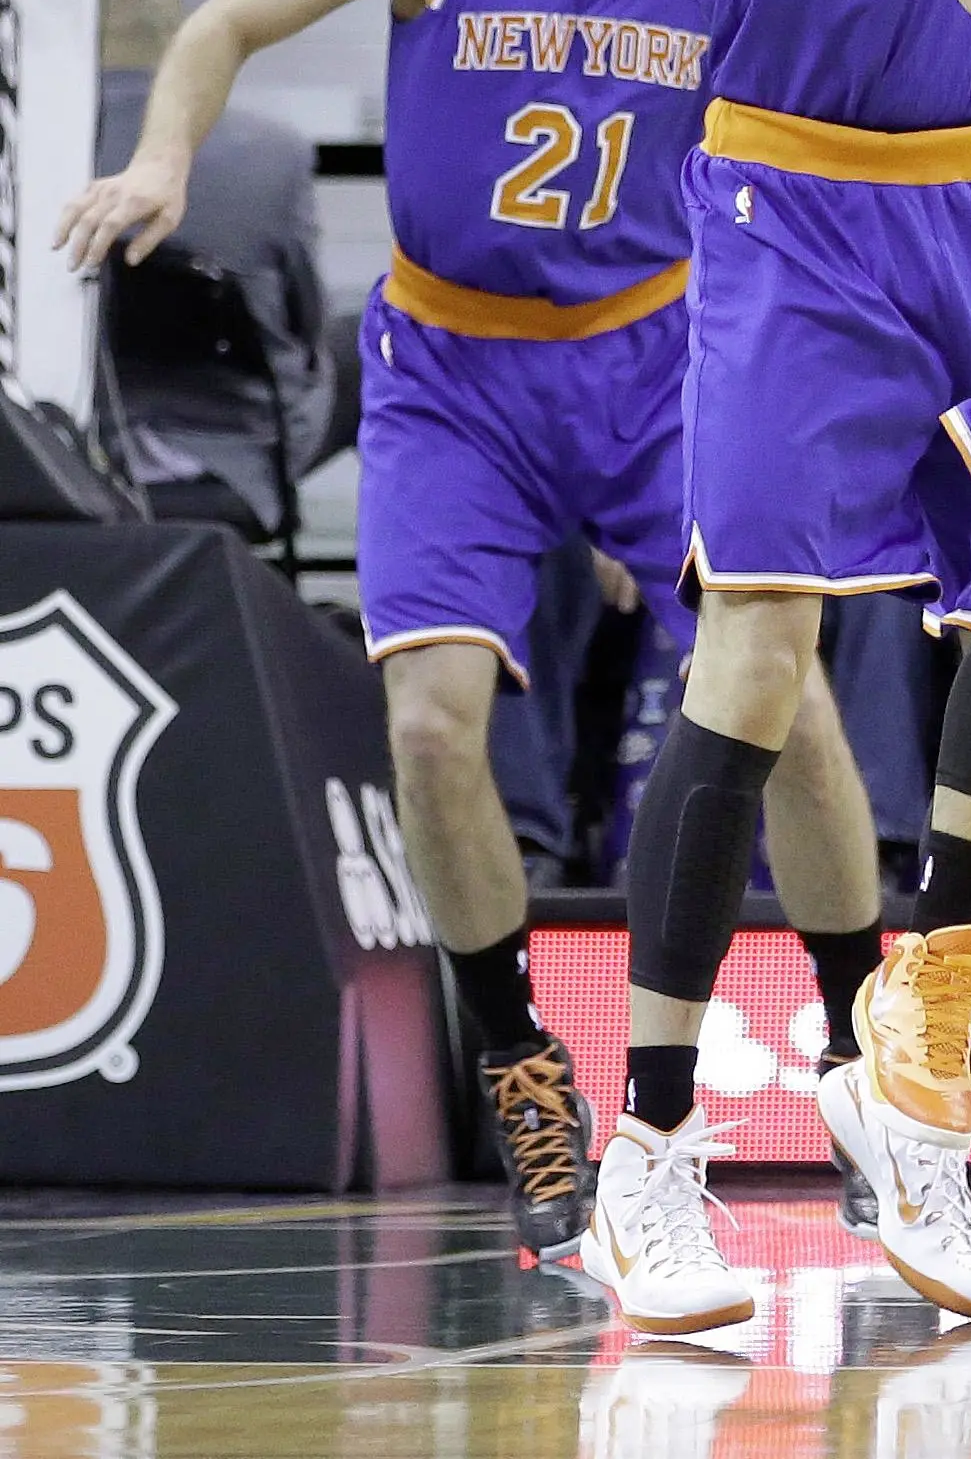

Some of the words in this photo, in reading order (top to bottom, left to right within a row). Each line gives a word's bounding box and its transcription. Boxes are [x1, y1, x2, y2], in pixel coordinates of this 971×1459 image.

[453, 11, 578, 74] NEW
[576, 16, 711, 91] YORK
[490, 102, 636, 231] 21
